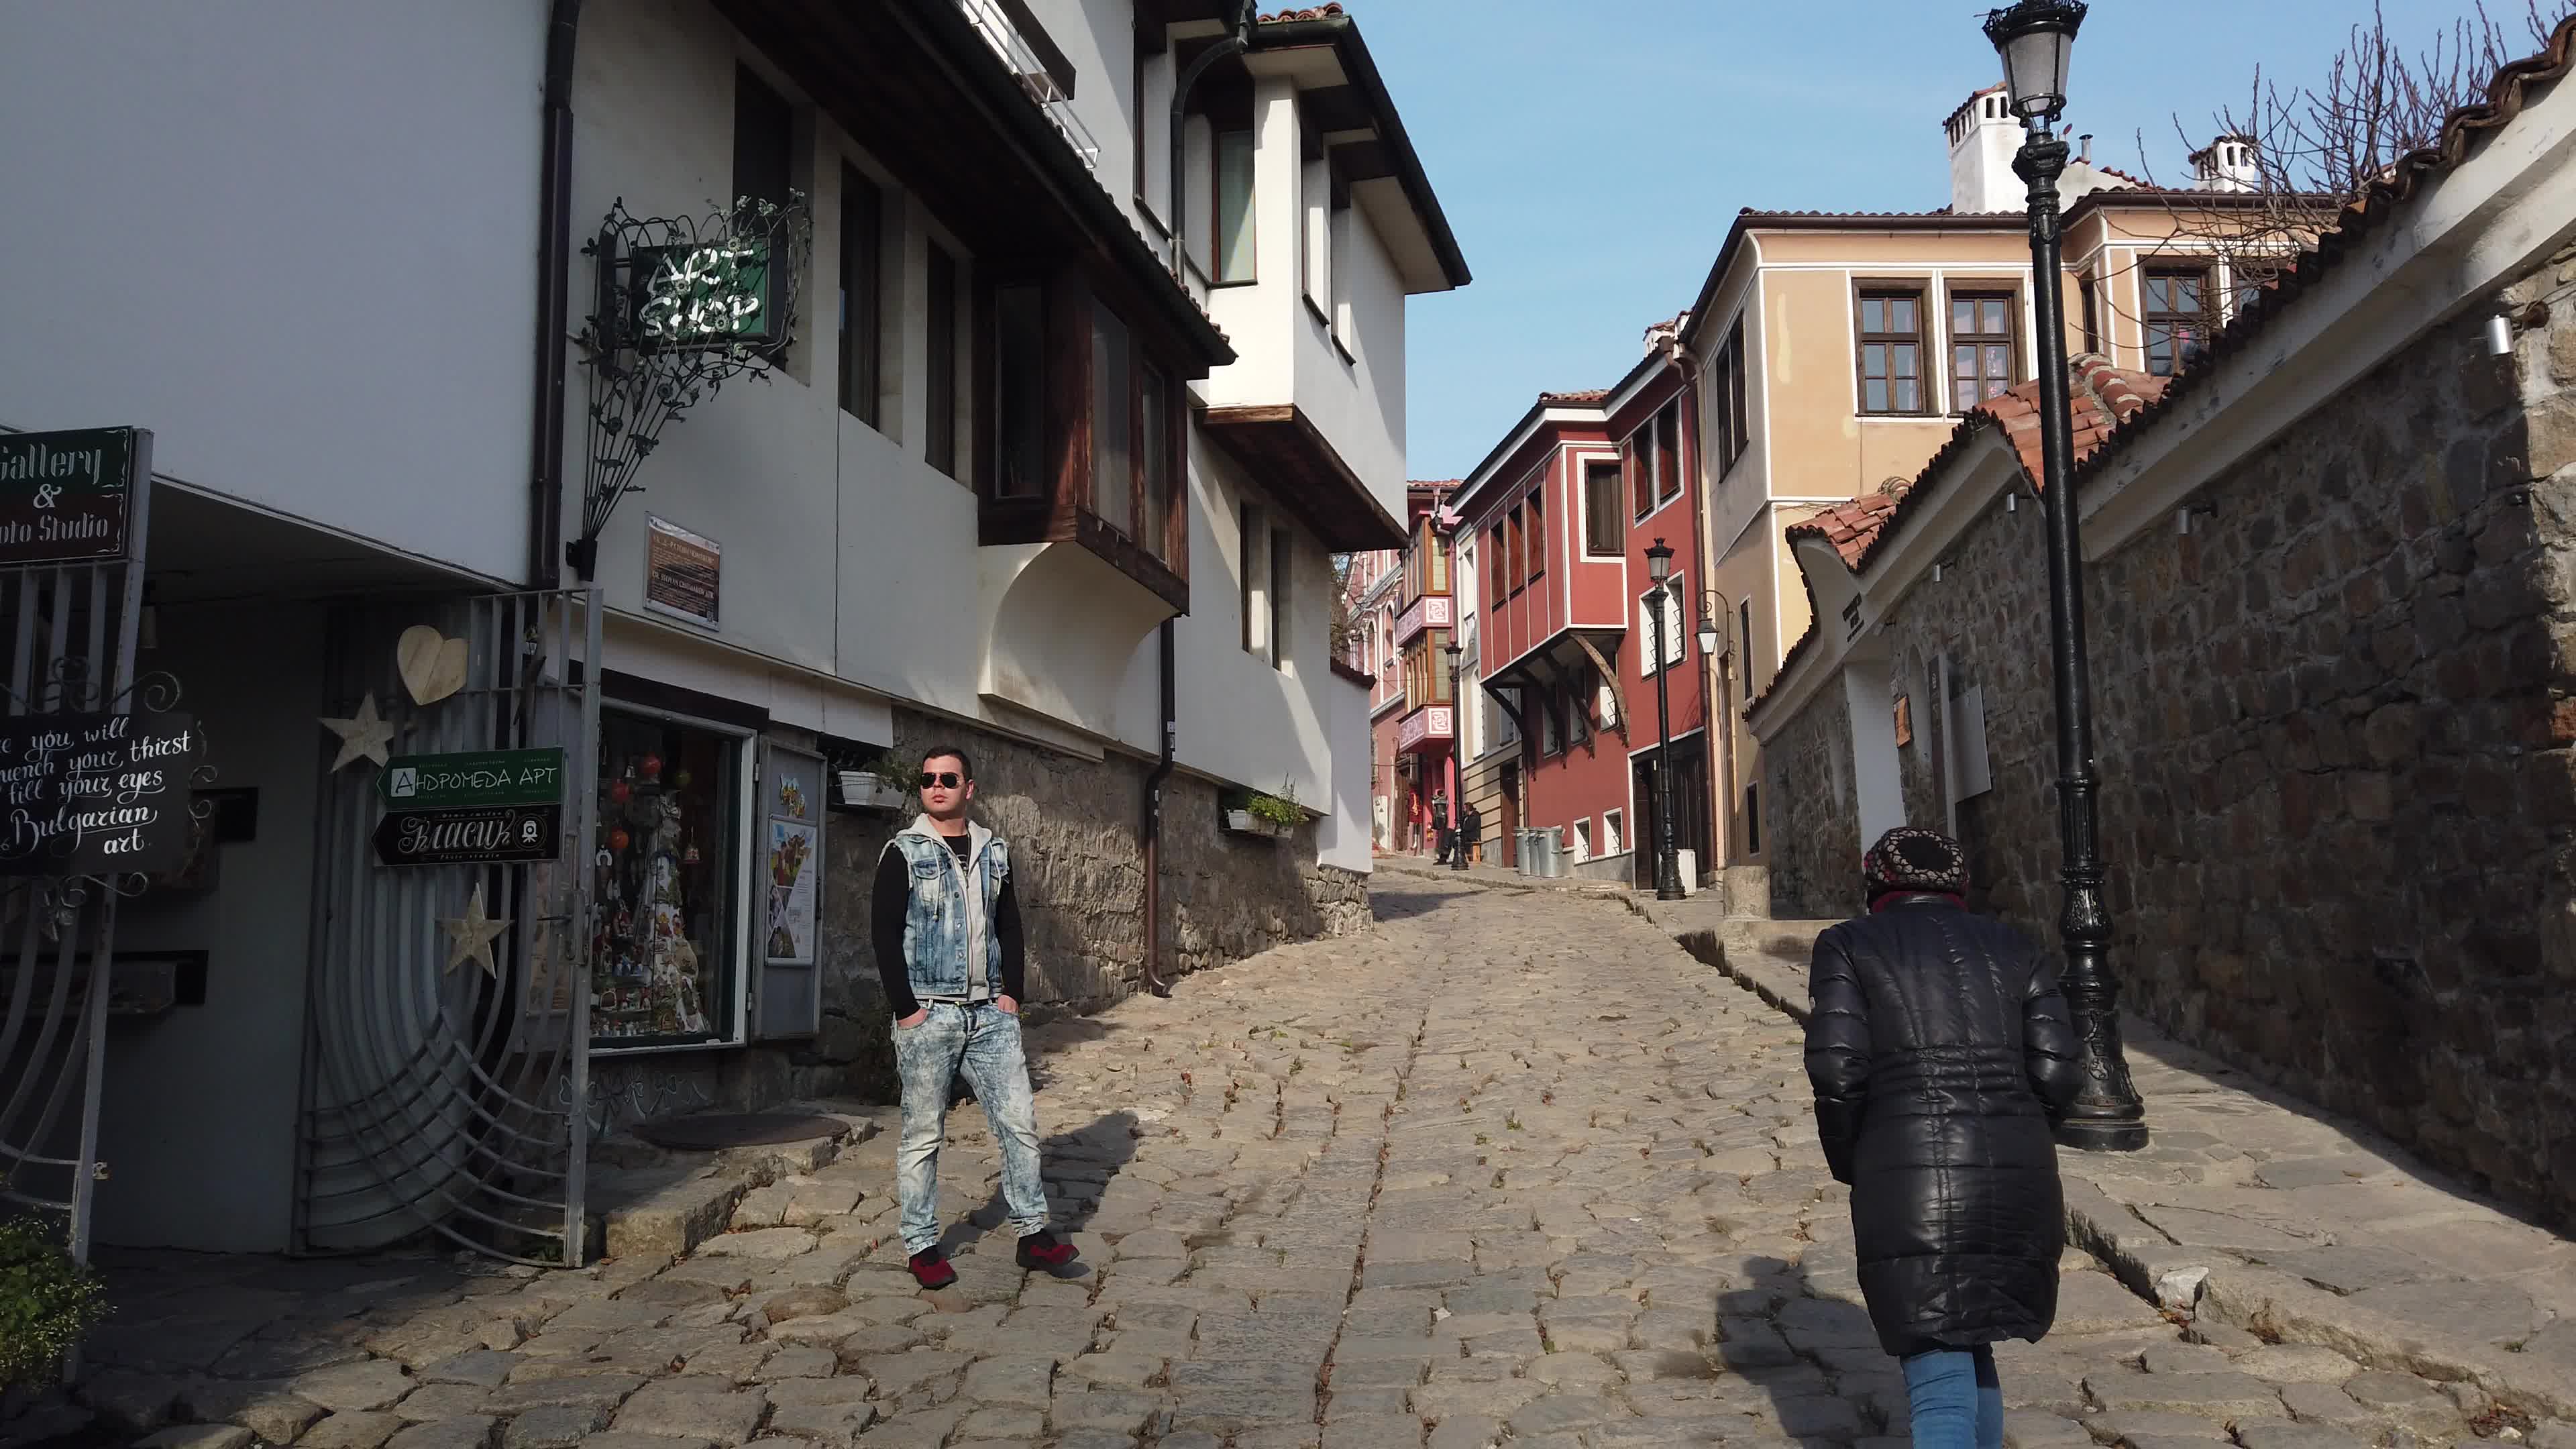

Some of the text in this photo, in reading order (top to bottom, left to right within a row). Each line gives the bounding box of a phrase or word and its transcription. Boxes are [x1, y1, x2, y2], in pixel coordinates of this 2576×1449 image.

[34, 484, 62, 508] &
[39, 512, 108, 541] Studio
[25, 729, 74, 762] you
[85, 716, 129, 742] will
[66, 751, 123, 782] your
[129, 730, 191, 762] thirst
[9, 769, 166, 805] fill your eyes
[10, 805, 158, 853] Bulgarian
